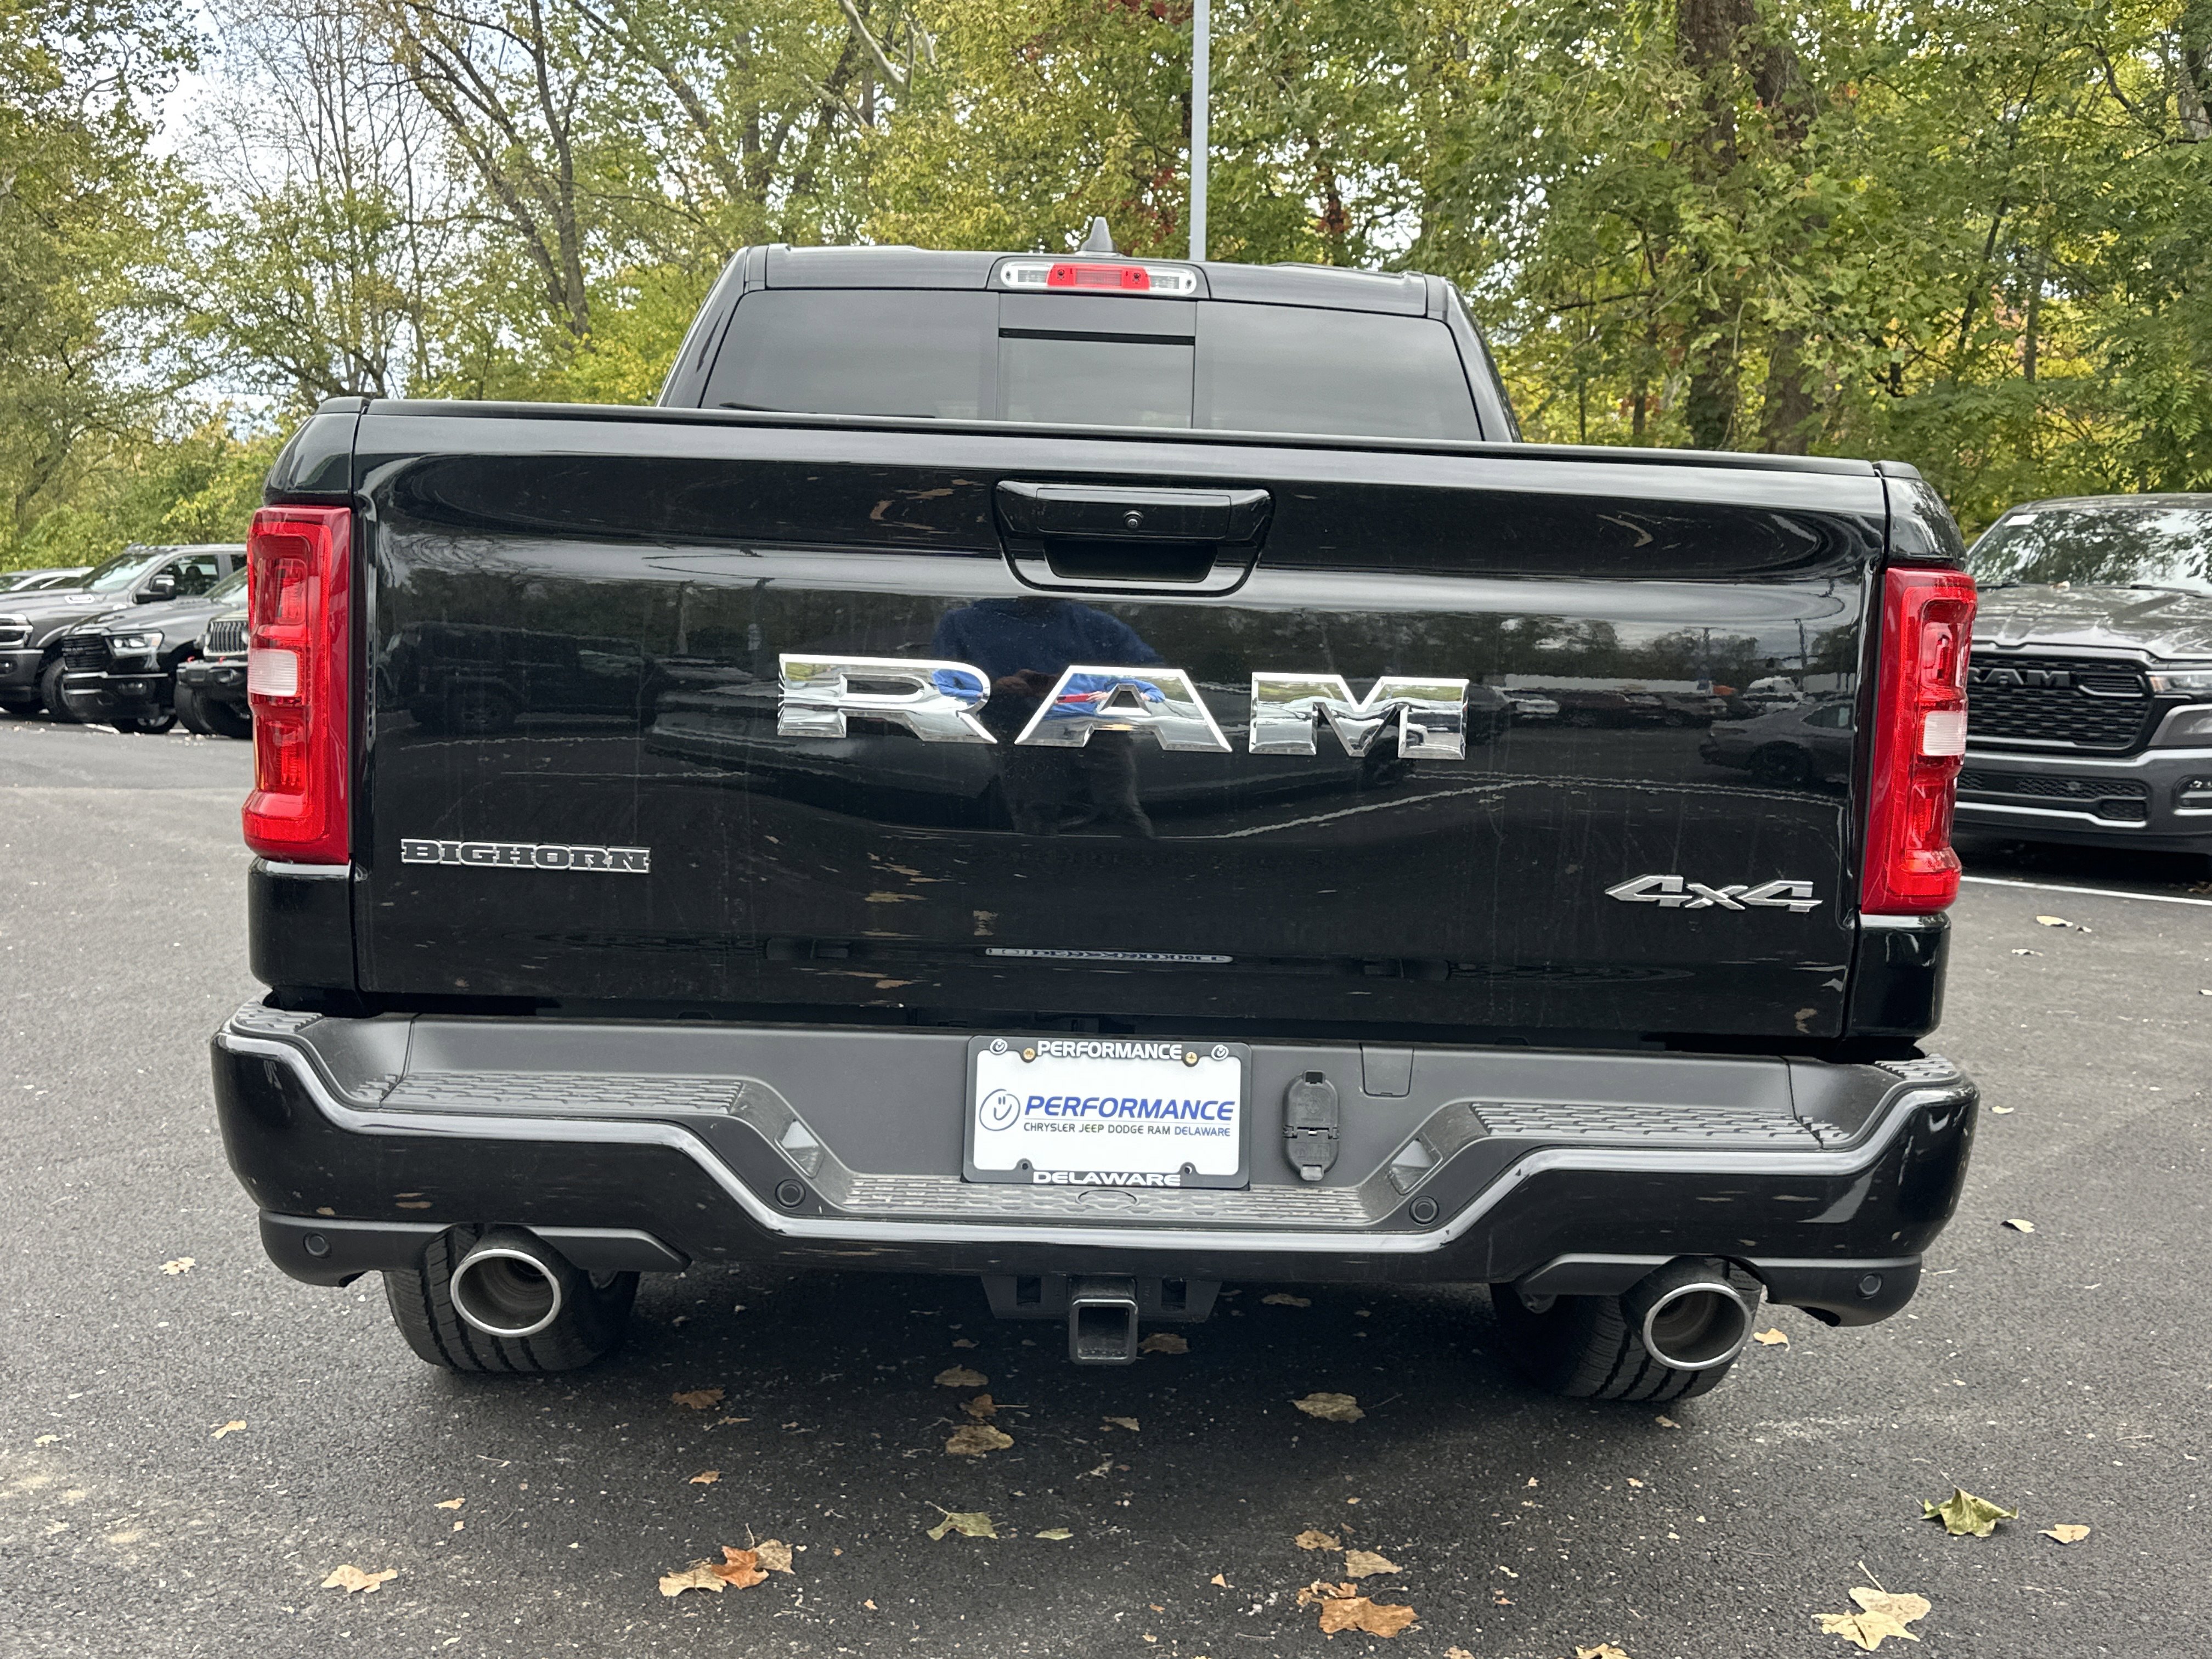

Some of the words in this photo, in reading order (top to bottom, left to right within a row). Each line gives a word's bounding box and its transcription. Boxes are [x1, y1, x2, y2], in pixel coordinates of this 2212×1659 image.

[777, 653, 1470, 760] RAM
[401, 838, 651, 873] BIGHORN
[1037, 1040, 1182, 1060] PERFORMANCE
[1024, 1095, 1235, 1121] PERFORMANCE
[1023, 1122, 1075, 1133] CHRYSLER
[1079, 1123, 1104, 1134] JEEP
[1108, 1124, 1144, 1135] DODGE
[1147, 1125, 1171, 1135] RAM
[1174, 1126, 1231, 1137] DELAWARE
[1032, 1171, 1181, 1187] DELAWARE
